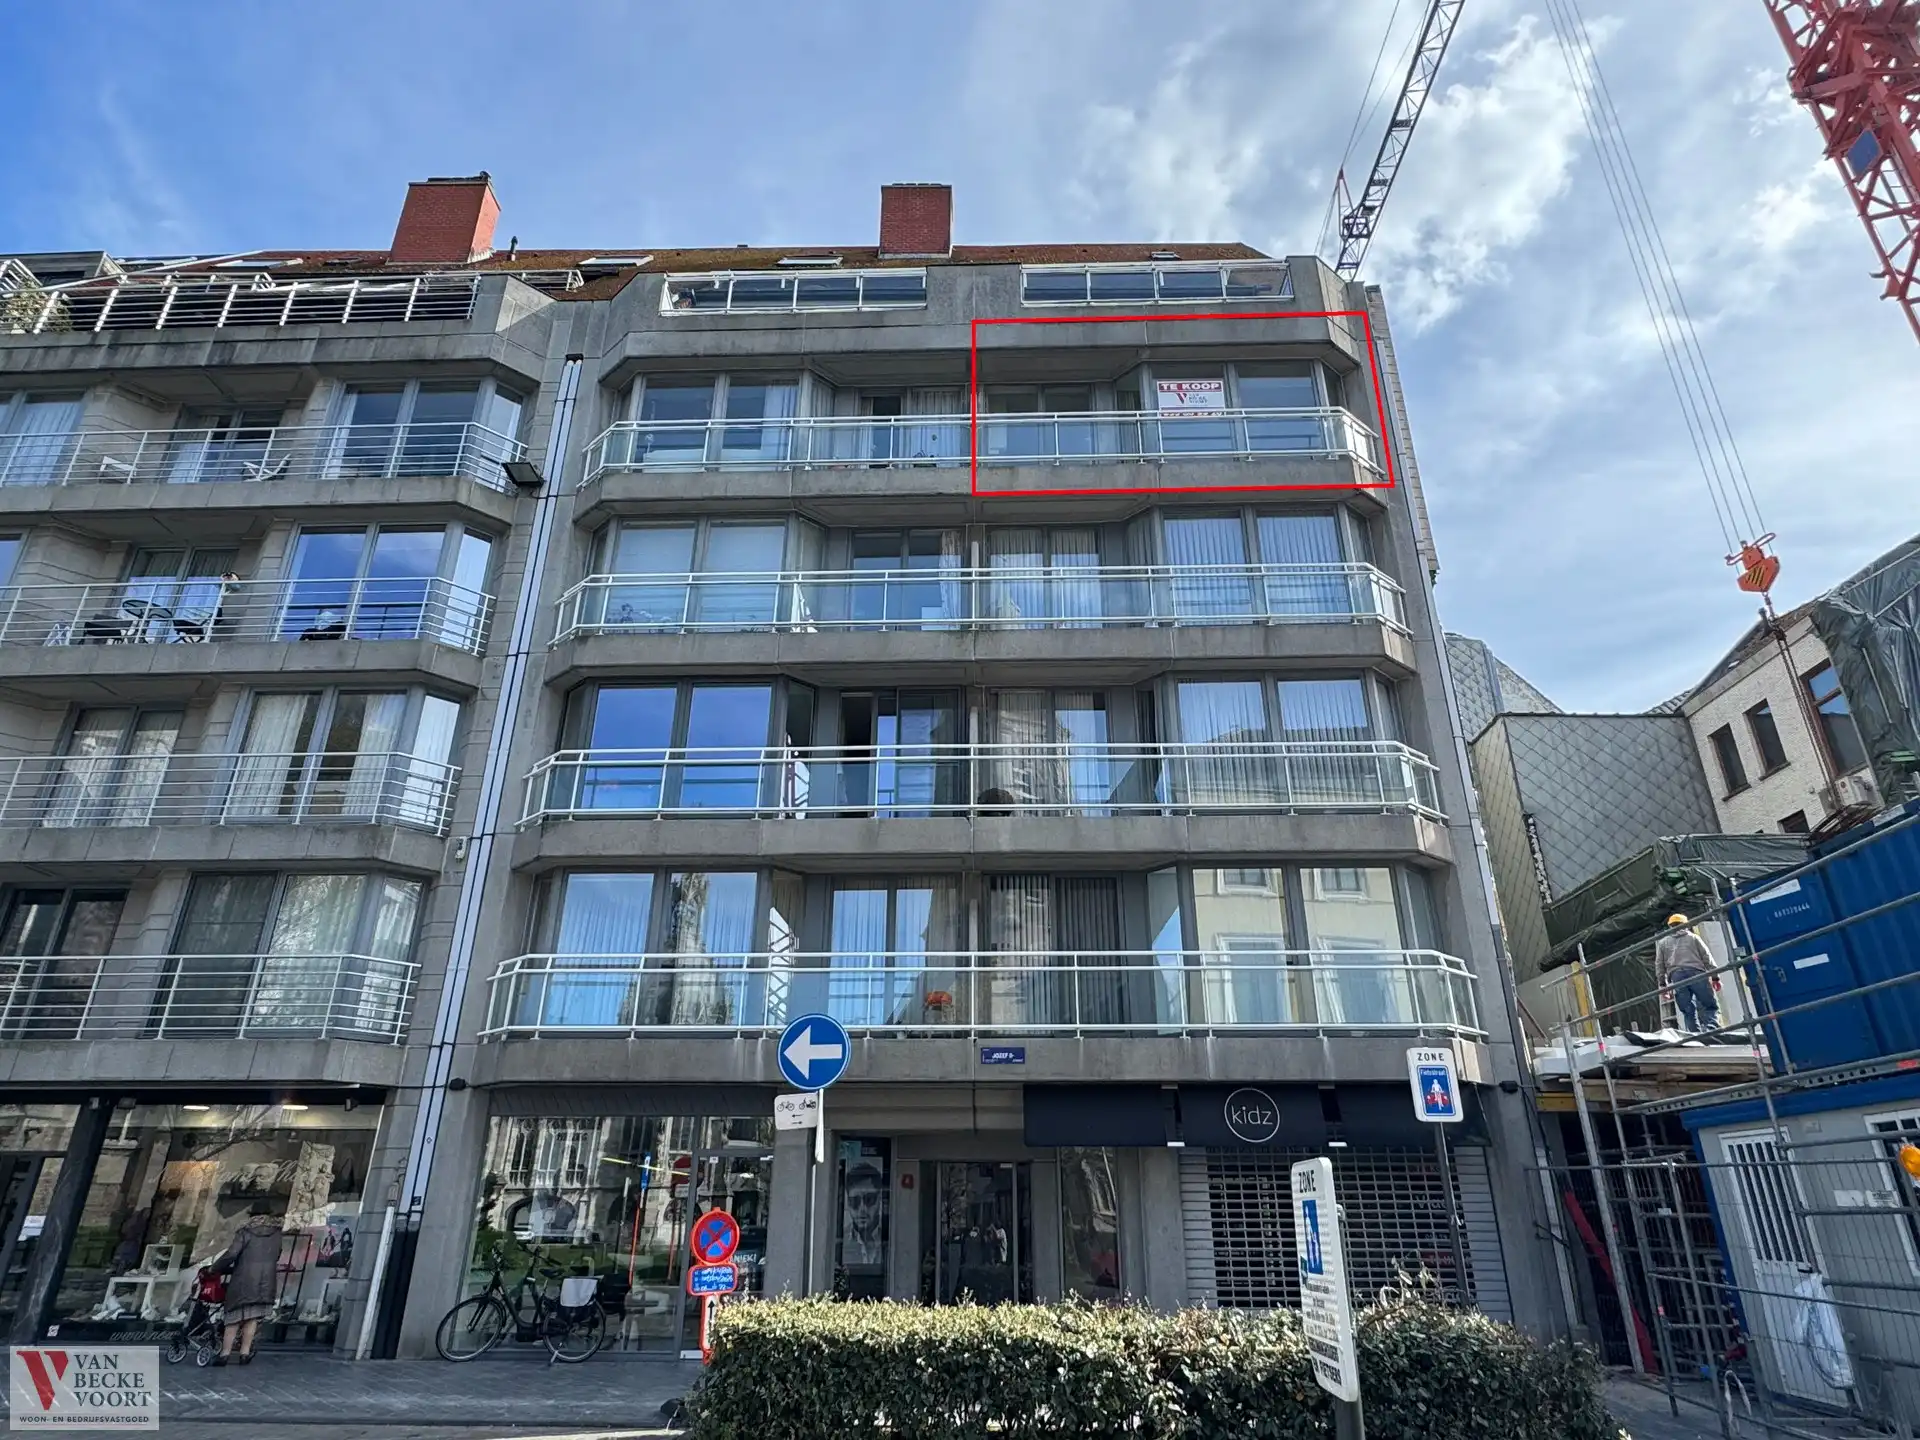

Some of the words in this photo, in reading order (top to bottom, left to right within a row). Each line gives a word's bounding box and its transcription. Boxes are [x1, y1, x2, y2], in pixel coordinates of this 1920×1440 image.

[1417, 1053, 1445, 1062] ZONE
[1231, 1104, 1273, 1125] kidz
[1298, 1169, 1317, 1193] ZONE
